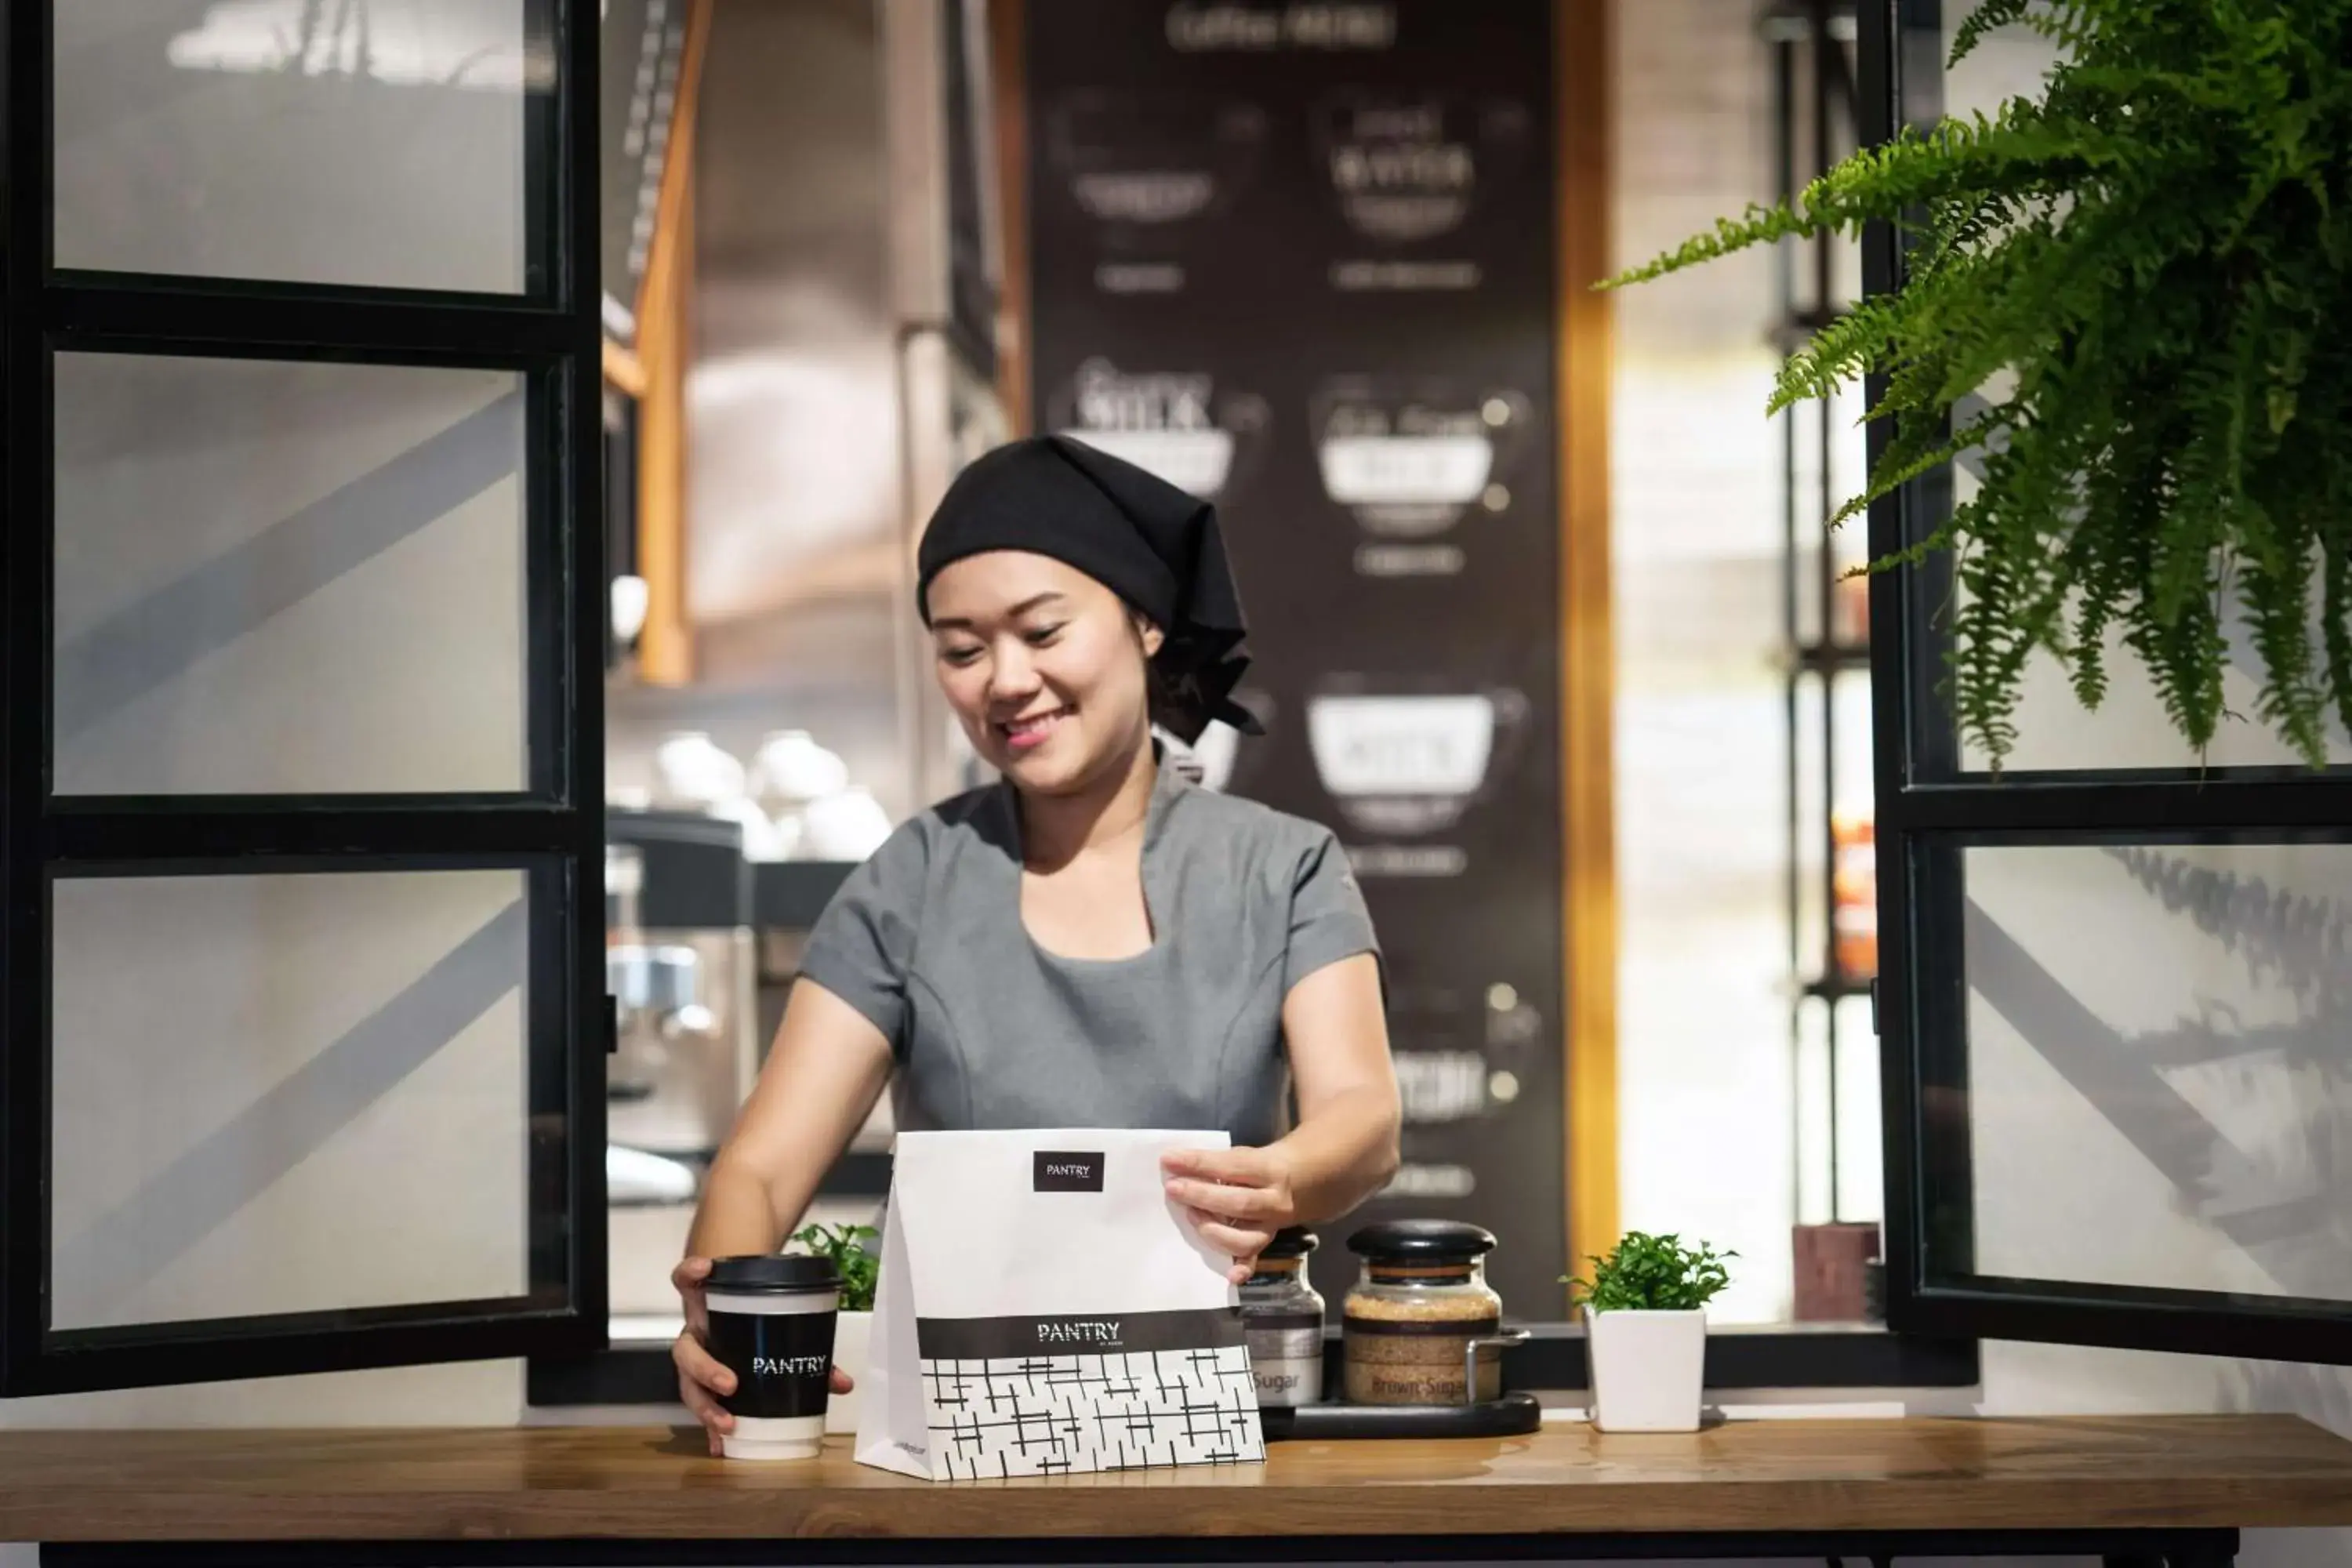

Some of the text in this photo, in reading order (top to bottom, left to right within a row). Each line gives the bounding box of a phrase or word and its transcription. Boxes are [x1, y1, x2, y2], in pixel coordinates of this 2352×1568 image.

[1047, 1164, 1091, 1175] PANTRY
[1037, 1322, 1120, 1342] PANTRY
[753, 1354, 826, 1374] PANTRY
[1253, 1371, 1300, 1394] Sugar
[1425, 1377, 1467, 1399] Suga
